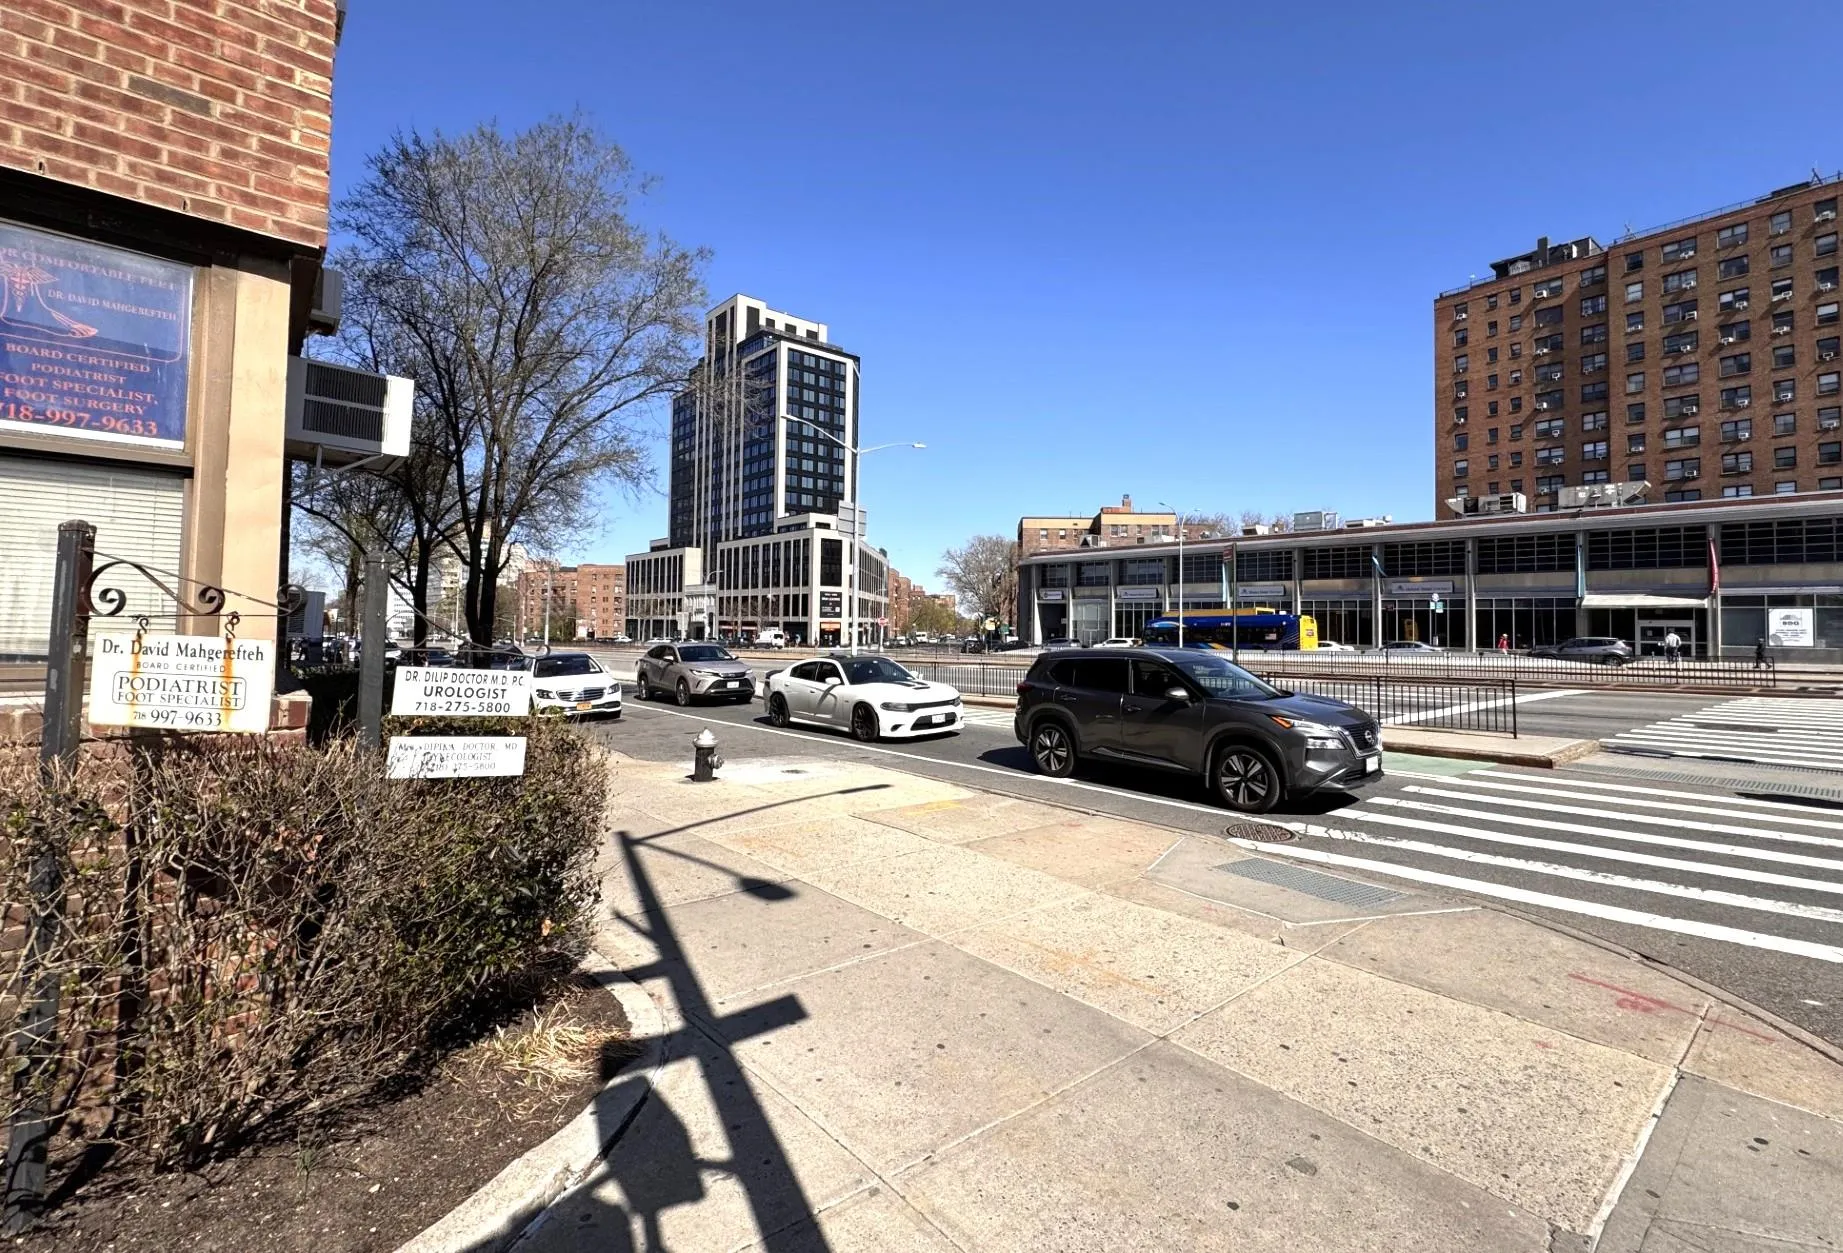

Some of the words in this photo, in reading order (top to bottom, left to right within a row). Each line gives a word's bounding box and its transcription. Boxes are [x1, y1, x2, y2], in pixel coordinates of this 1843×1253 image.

[68, 293, 100, 306] DAVID
[5, 343, 63, 359] BOARD
[66, 352, 150, 373] CERTIFIED
[31, 363, 127, 384] PODIATRIST
[4, 387, 59, 404] FOOT
[63, 396, 147, 415] SURGERY
[52, 380, 159, 405] SPECIALIST,
[102, 638, 124, 655] Dr.
[131, 640, 169, 657] David
[176, 643, 264, 662] Mahgerefteh
[136, 661, 169, 670] BOARD
[176, 663, 226, 673] CERTIFIED
[119, 676, 242, 695] PODIATRIST
[405, 670, 421, 682] DR.
[425, 671, 448, 682] DILIP
[451, 673, 488, 684] DOCTOR
[118, 690, 153, 703] FOOT
[160, 693, 241, 707] SPECIALIST
[423, 686, 507, 699] UROLOGIST
[415, 701, 511, 713] 718-275-5800
[133, 711, 147, 720] 718
[151, 709, 222, 726] 997-9633
[463, 743, 496, 751] DOCTOR
[505, 743, 518, 751] MD
